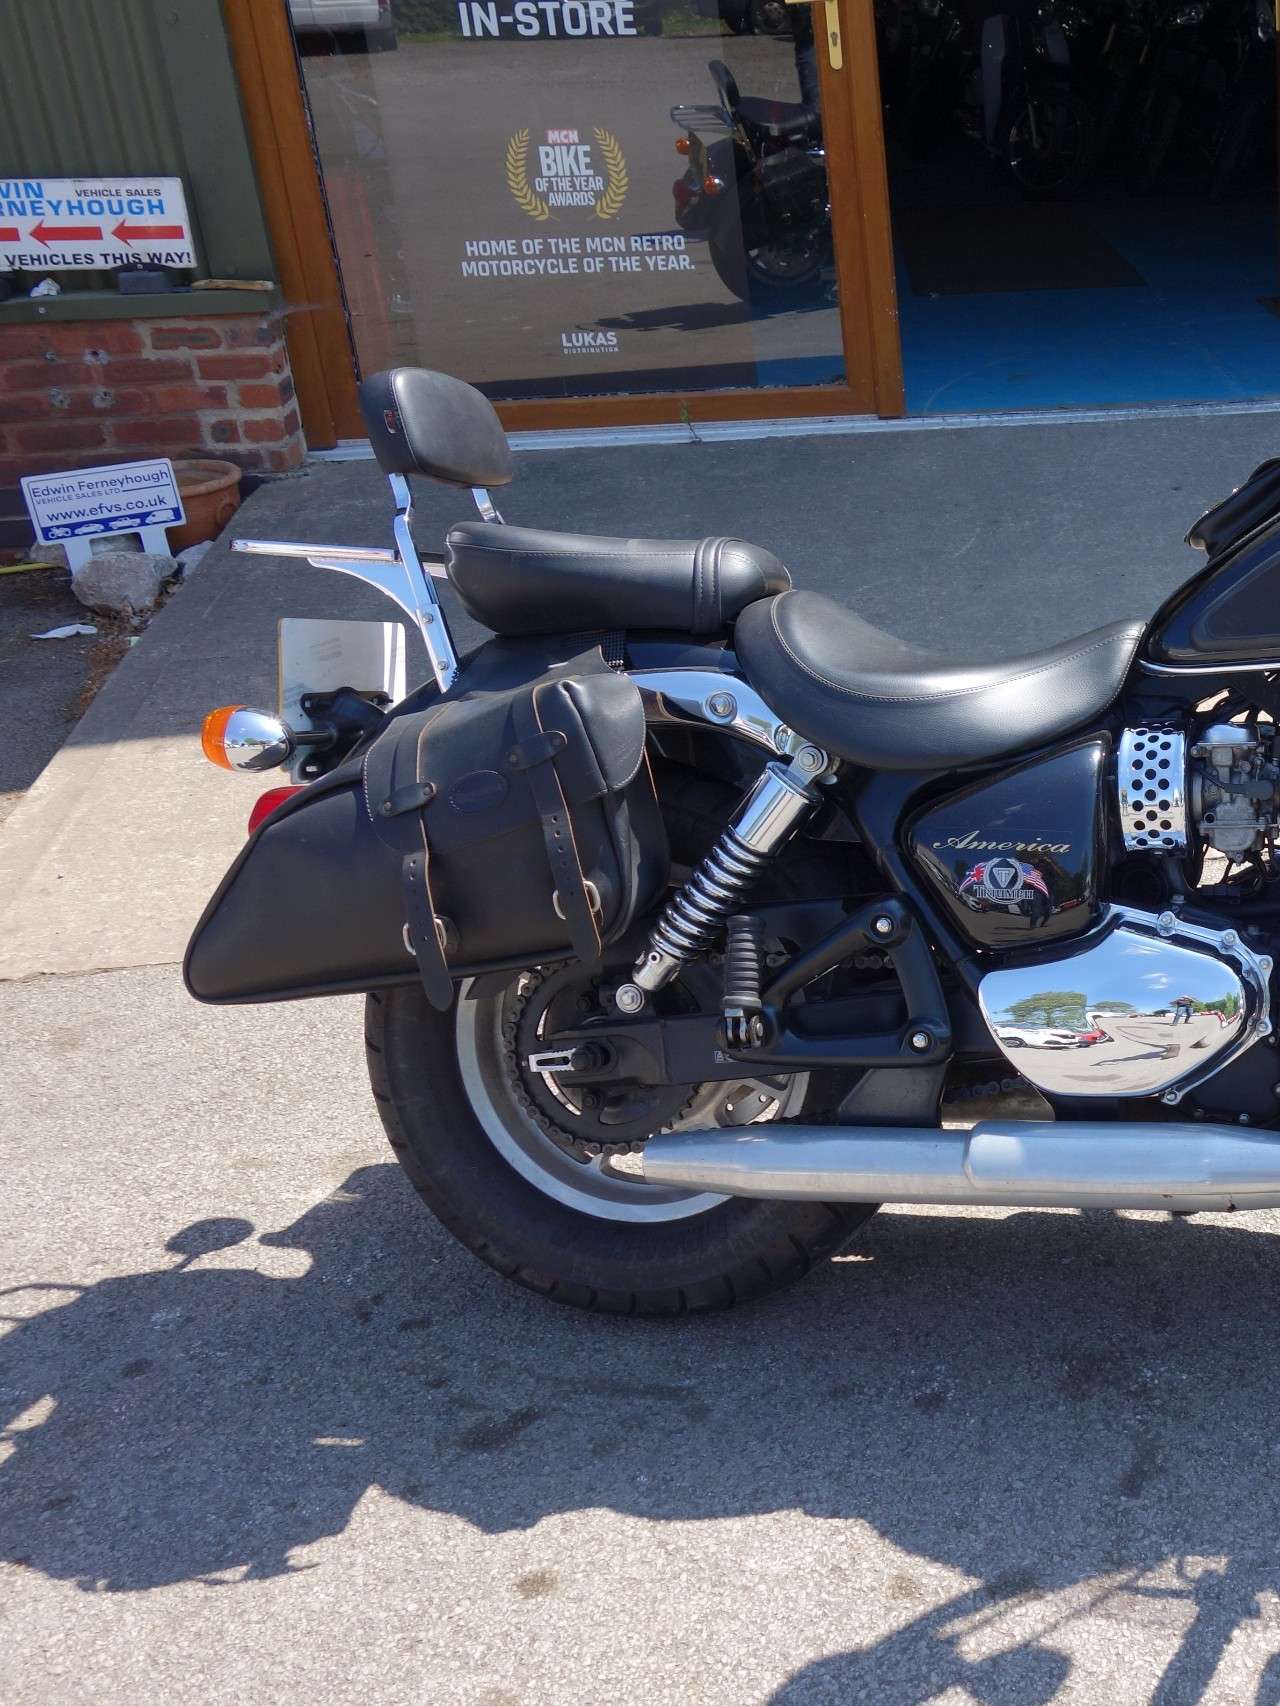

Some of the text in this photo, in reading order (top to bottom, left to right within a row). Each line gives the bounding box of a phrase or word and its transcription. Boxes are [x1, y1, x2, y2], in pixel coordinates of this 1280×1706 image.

[458, 1, 638, 37] IN-STORE
[548, 130, 579, 144] MCN
[539, 145, 594, 176] BIKE
[75, 188, 161, 198] VEHICLE SALES
[535, 176, 604, 192] OF THE YEAR
[548, 191, 596, 206] AWARDS
[465, 235, 686, 257] HOME OF THE MCN RETRO
[5, 251, 192, 267] VEHICLES THIS WAY!
[461, 254, 695, 277] MOTORCYCLE OF THE YEAR.
[561, 331, 617, 347] LUKAS
[32, 470, 169, 498] Edwin Ferneyhough
[35, 487, 121, 505] VEHICLE SALES LTD
[46, 495, 168, 522] www.efvs.co.uk
[932, 830, 1072, 854] America
[973, 884, 1034, 902] TRIUMPH
